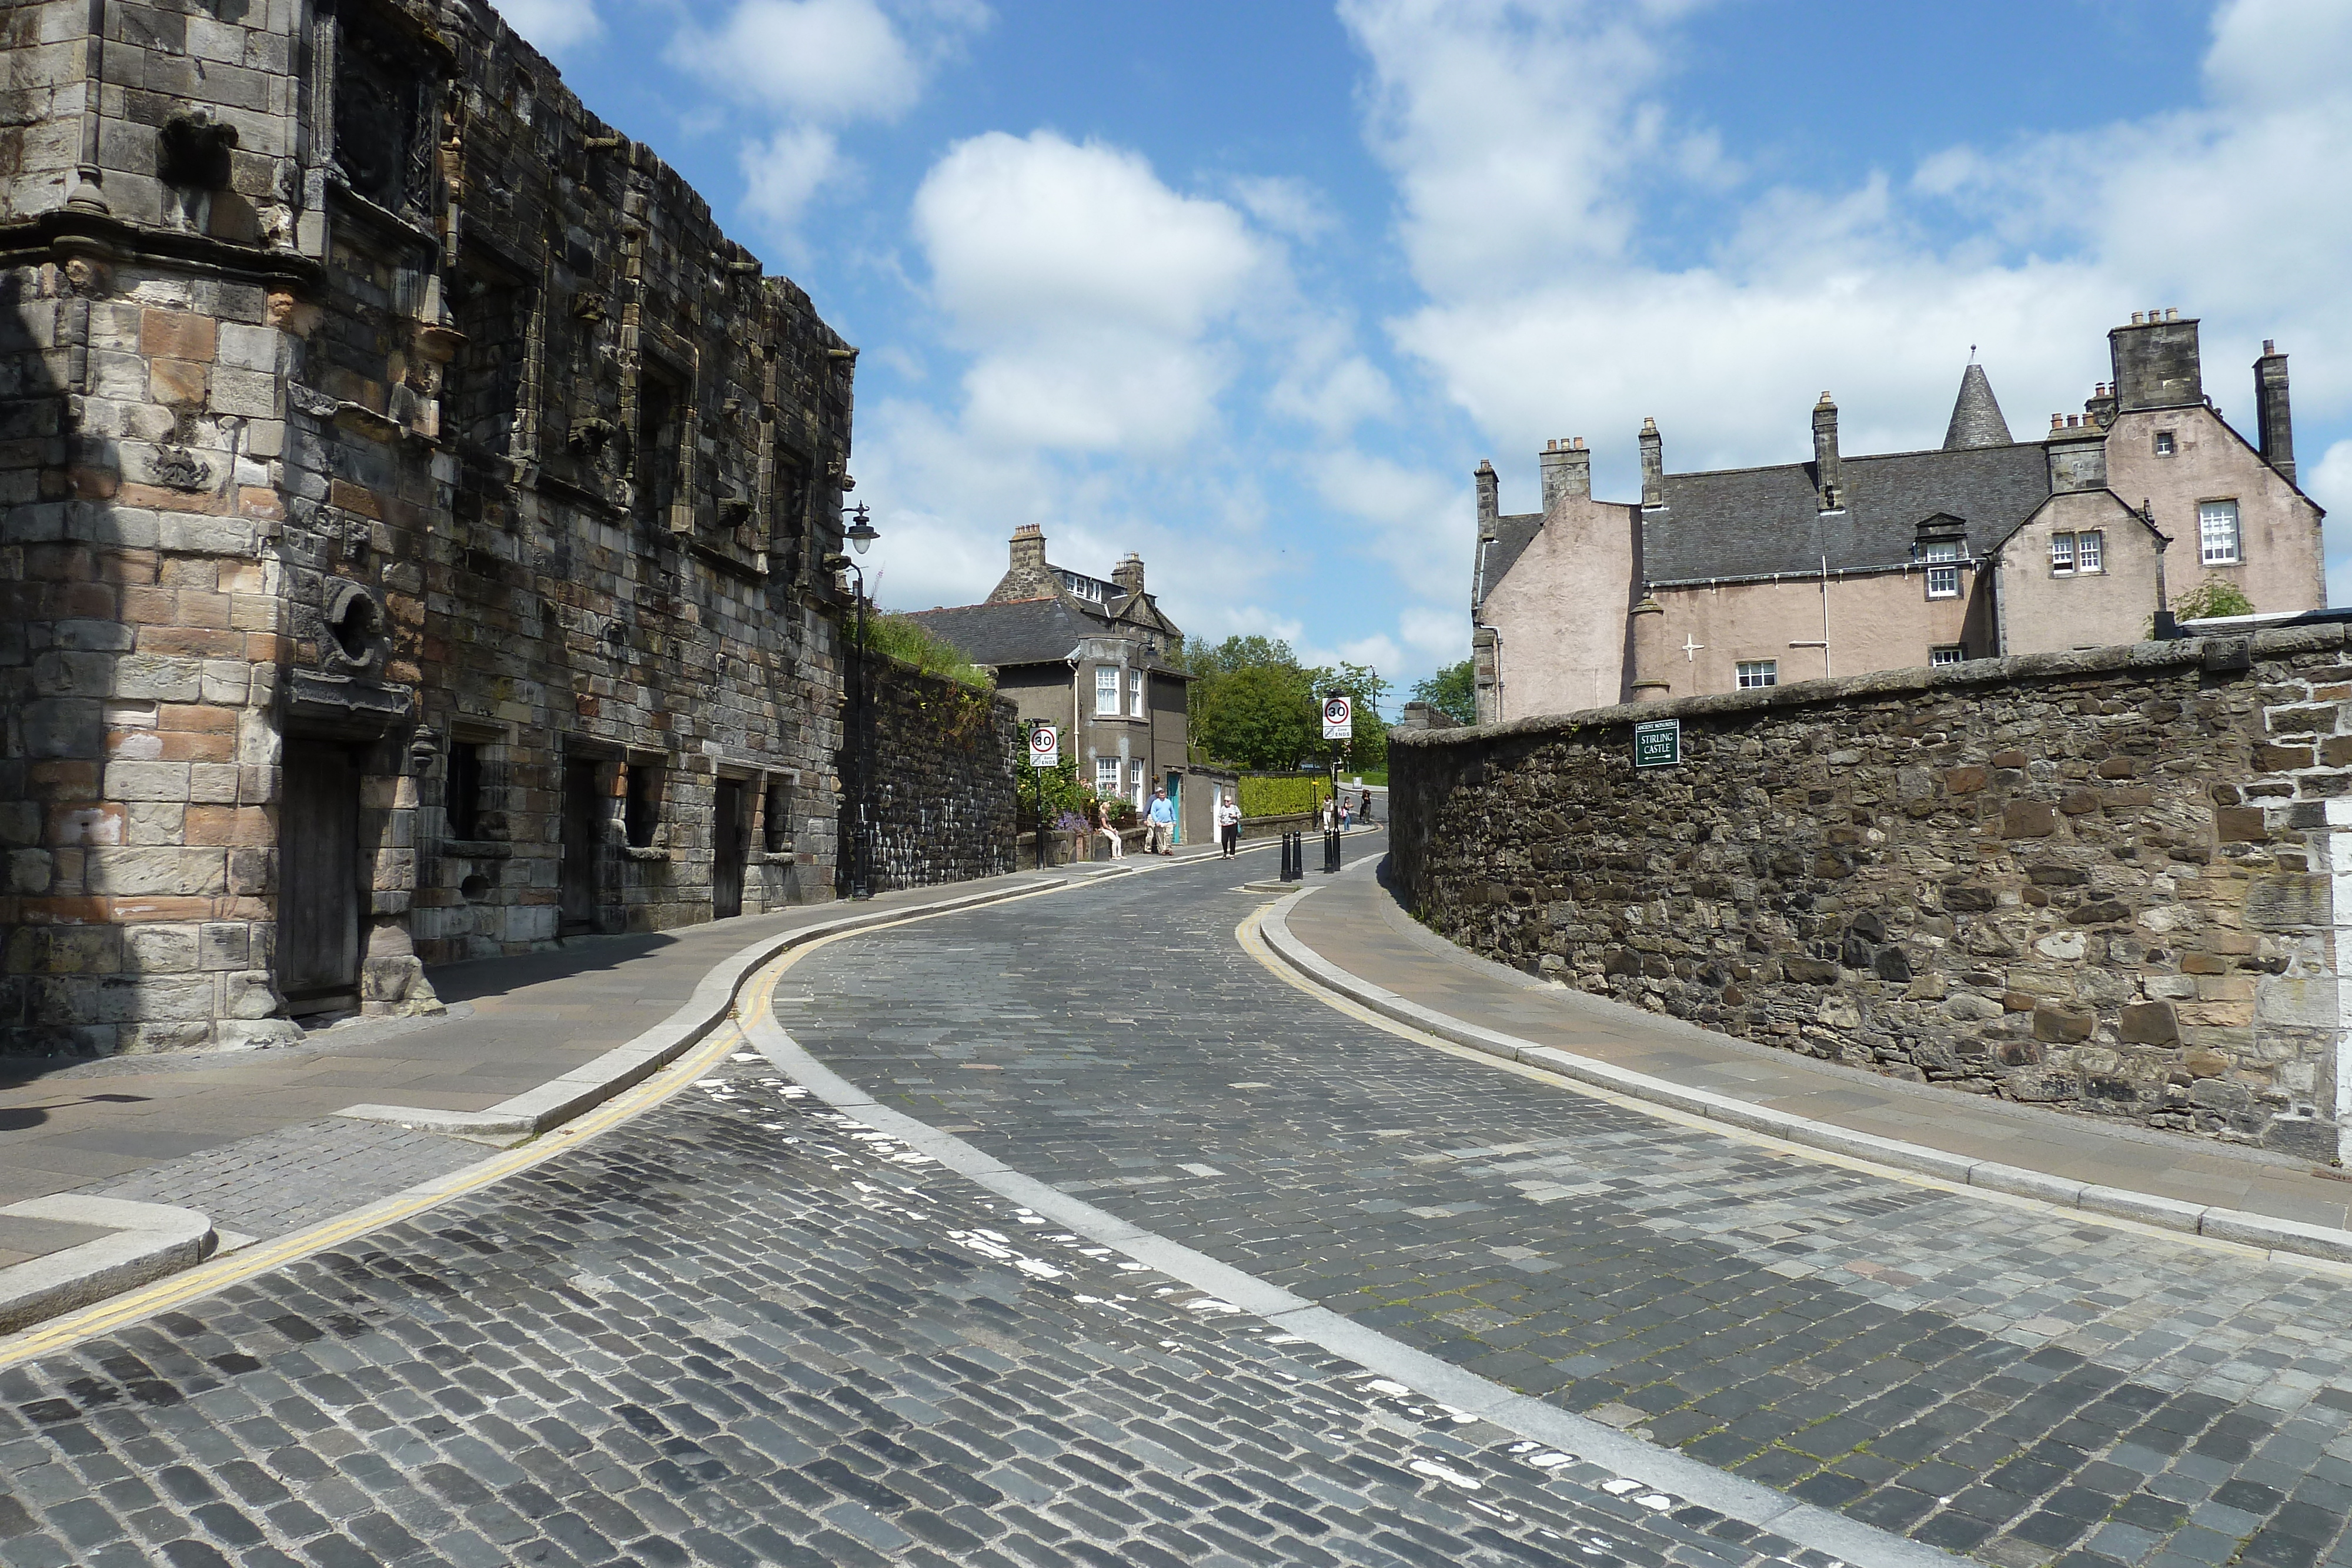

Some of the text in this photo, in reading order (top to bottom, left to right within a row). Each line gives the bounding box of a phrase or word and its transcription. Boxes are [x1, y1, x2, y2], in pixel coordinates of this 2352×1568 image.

[1328, 707, 1345, 717] 30
[1035, 736, 1051, 745] 30
[1641, 733, 1673, 744] STIRLING
[1644, 743, 1671, 754] CASTLE
